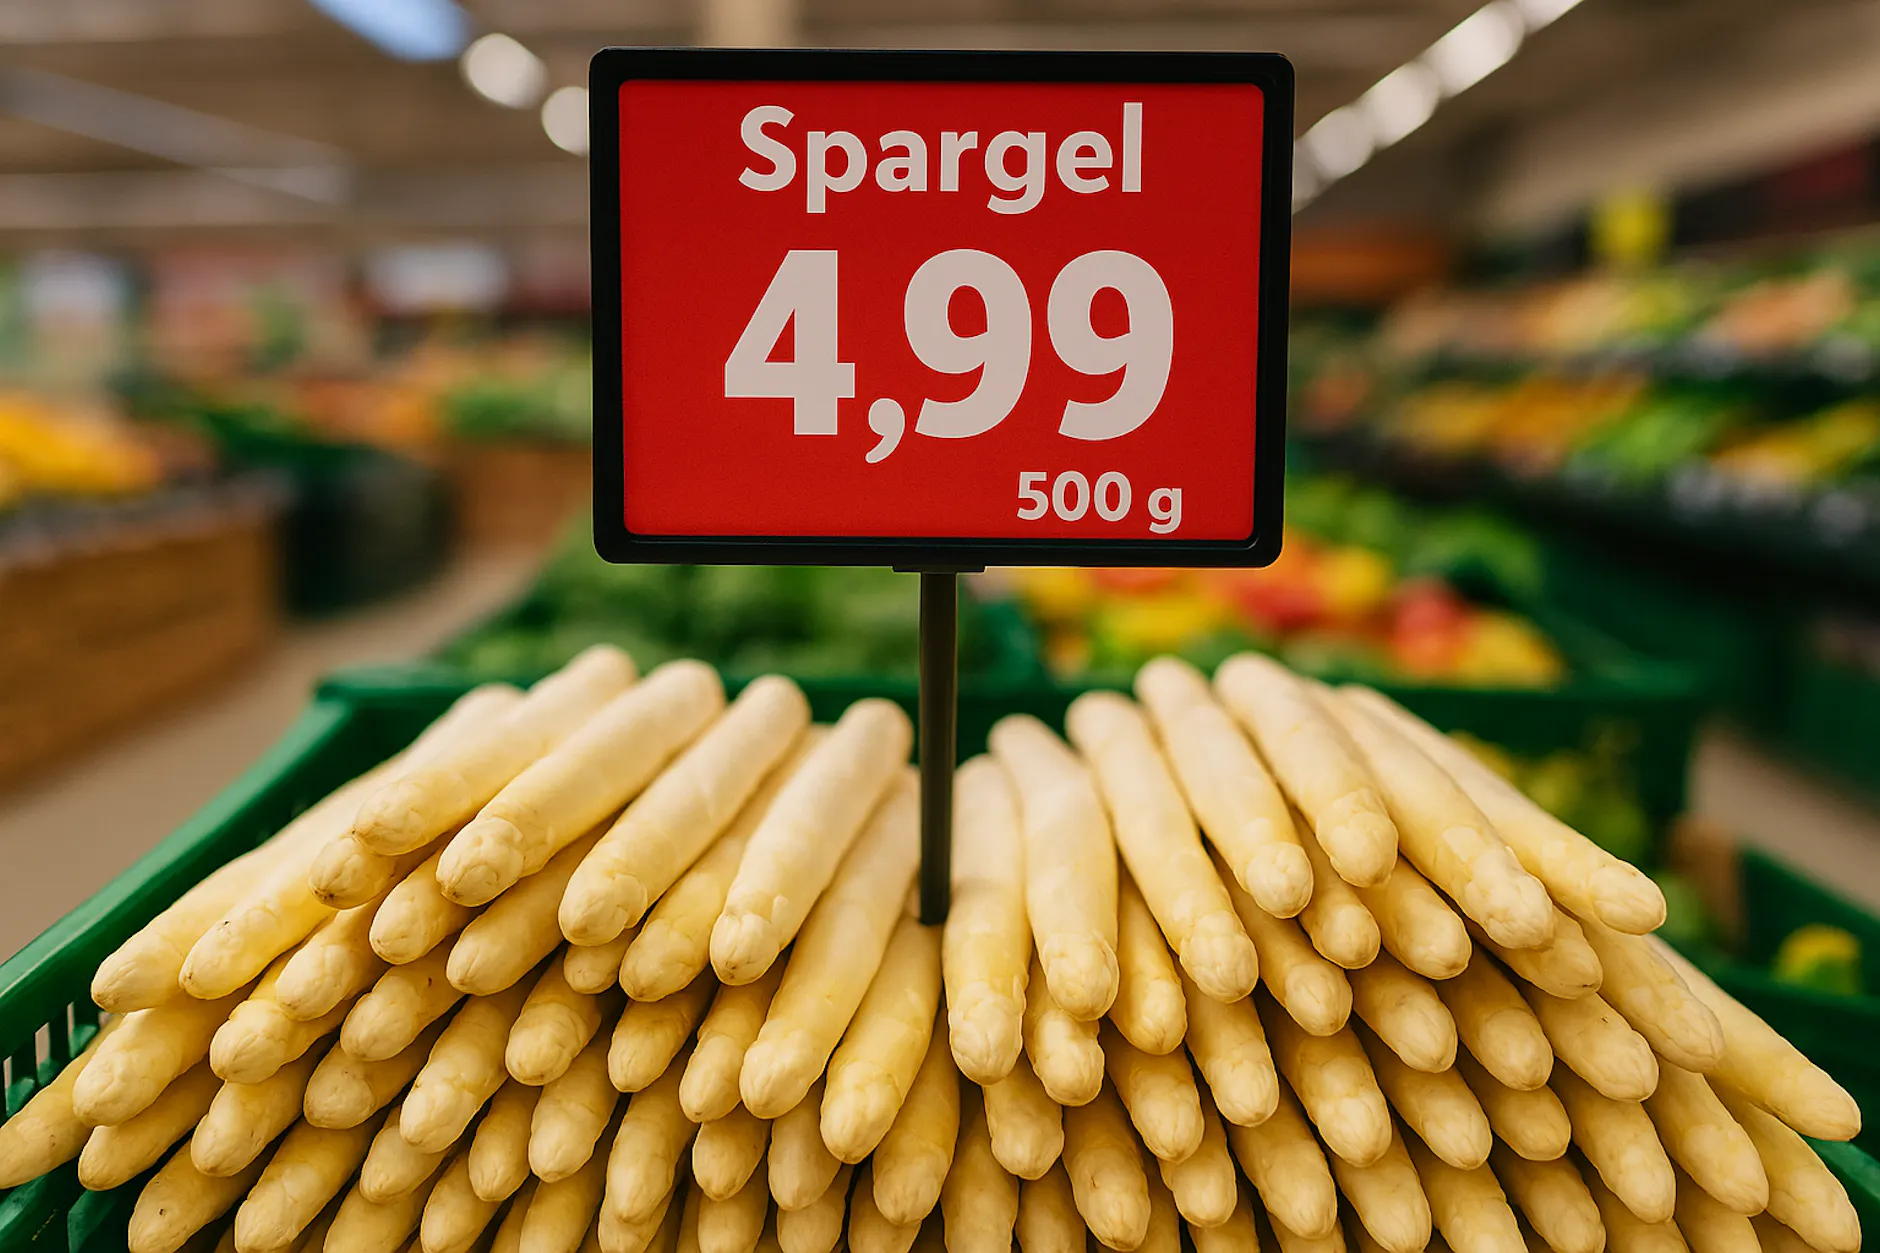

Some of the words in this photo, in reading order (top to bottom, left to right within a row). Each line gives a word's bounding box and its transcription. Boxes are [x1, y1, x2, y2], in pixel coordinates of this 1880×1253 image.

[739, 102, 1142, 214] Spargel
[724, 249, 1174, 463] 4,99
[1017, 471, 1131, 521] 500
[1148, 488, 1182, 533] g
